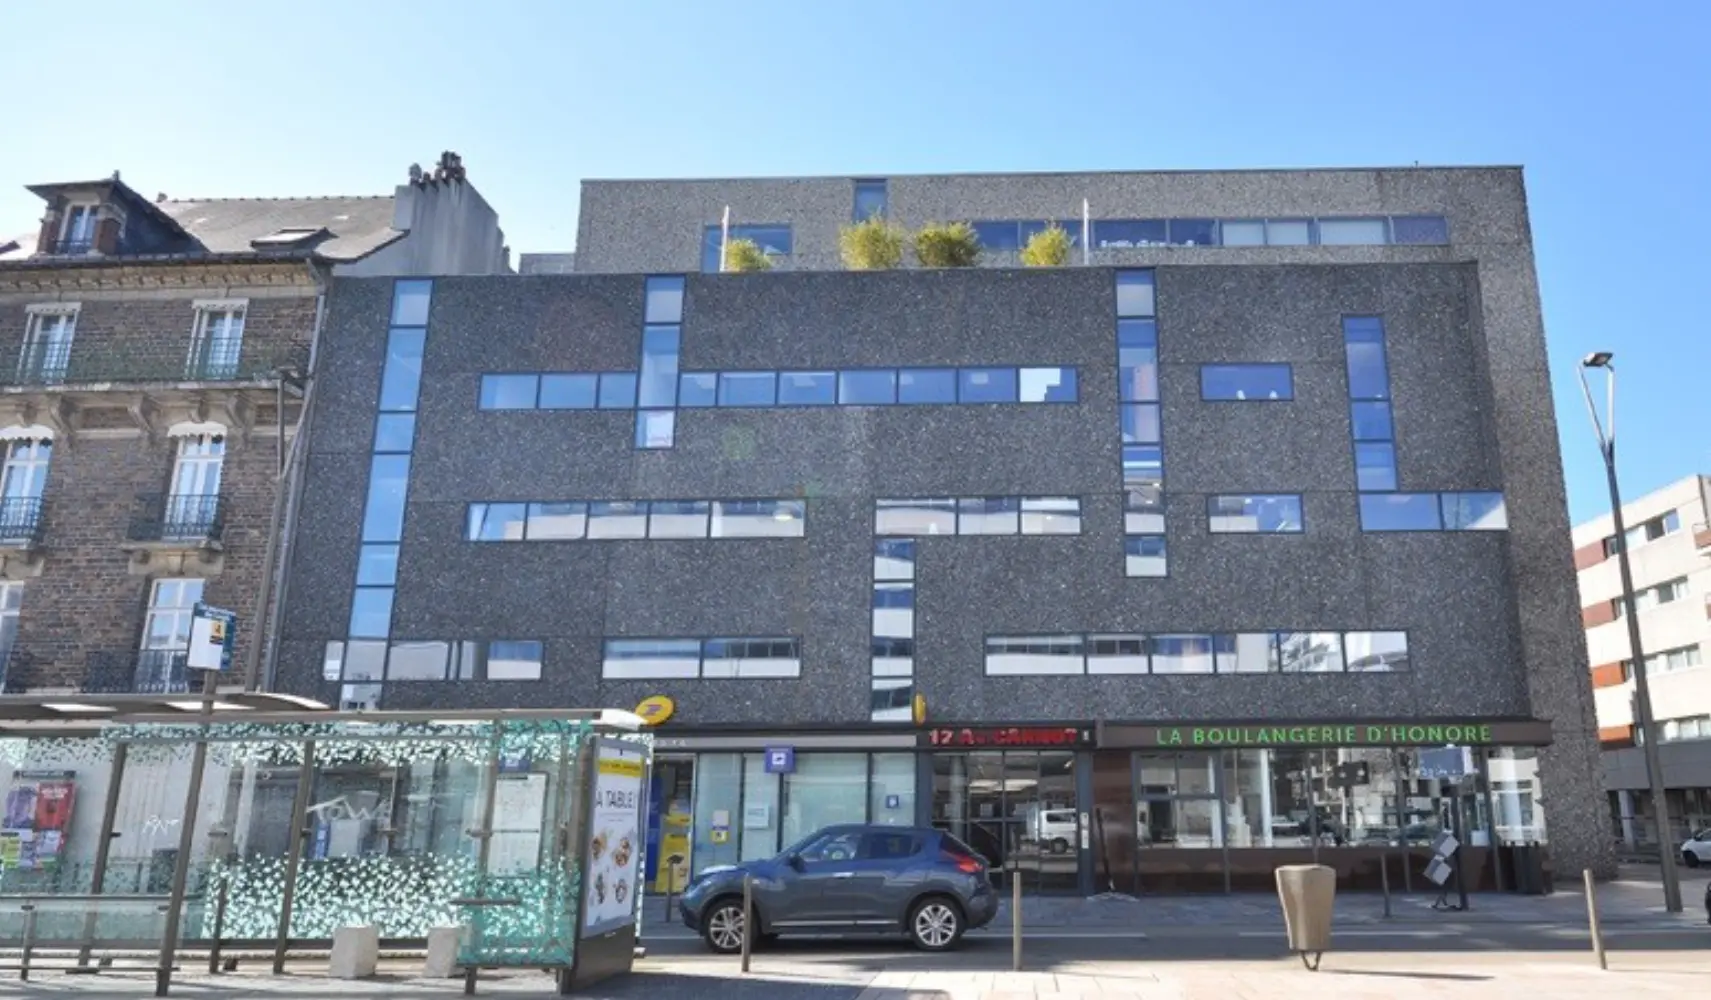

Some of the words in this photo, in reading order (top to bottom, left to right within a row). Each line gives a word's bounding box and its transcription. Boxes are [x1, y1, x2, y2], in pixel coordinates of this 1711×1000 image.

[1156, 728, 1182, 745] LA
[1193, 726, 1356, 745] BOULANGERIE
[1366, 725, 1491, 743] D'HONORE
